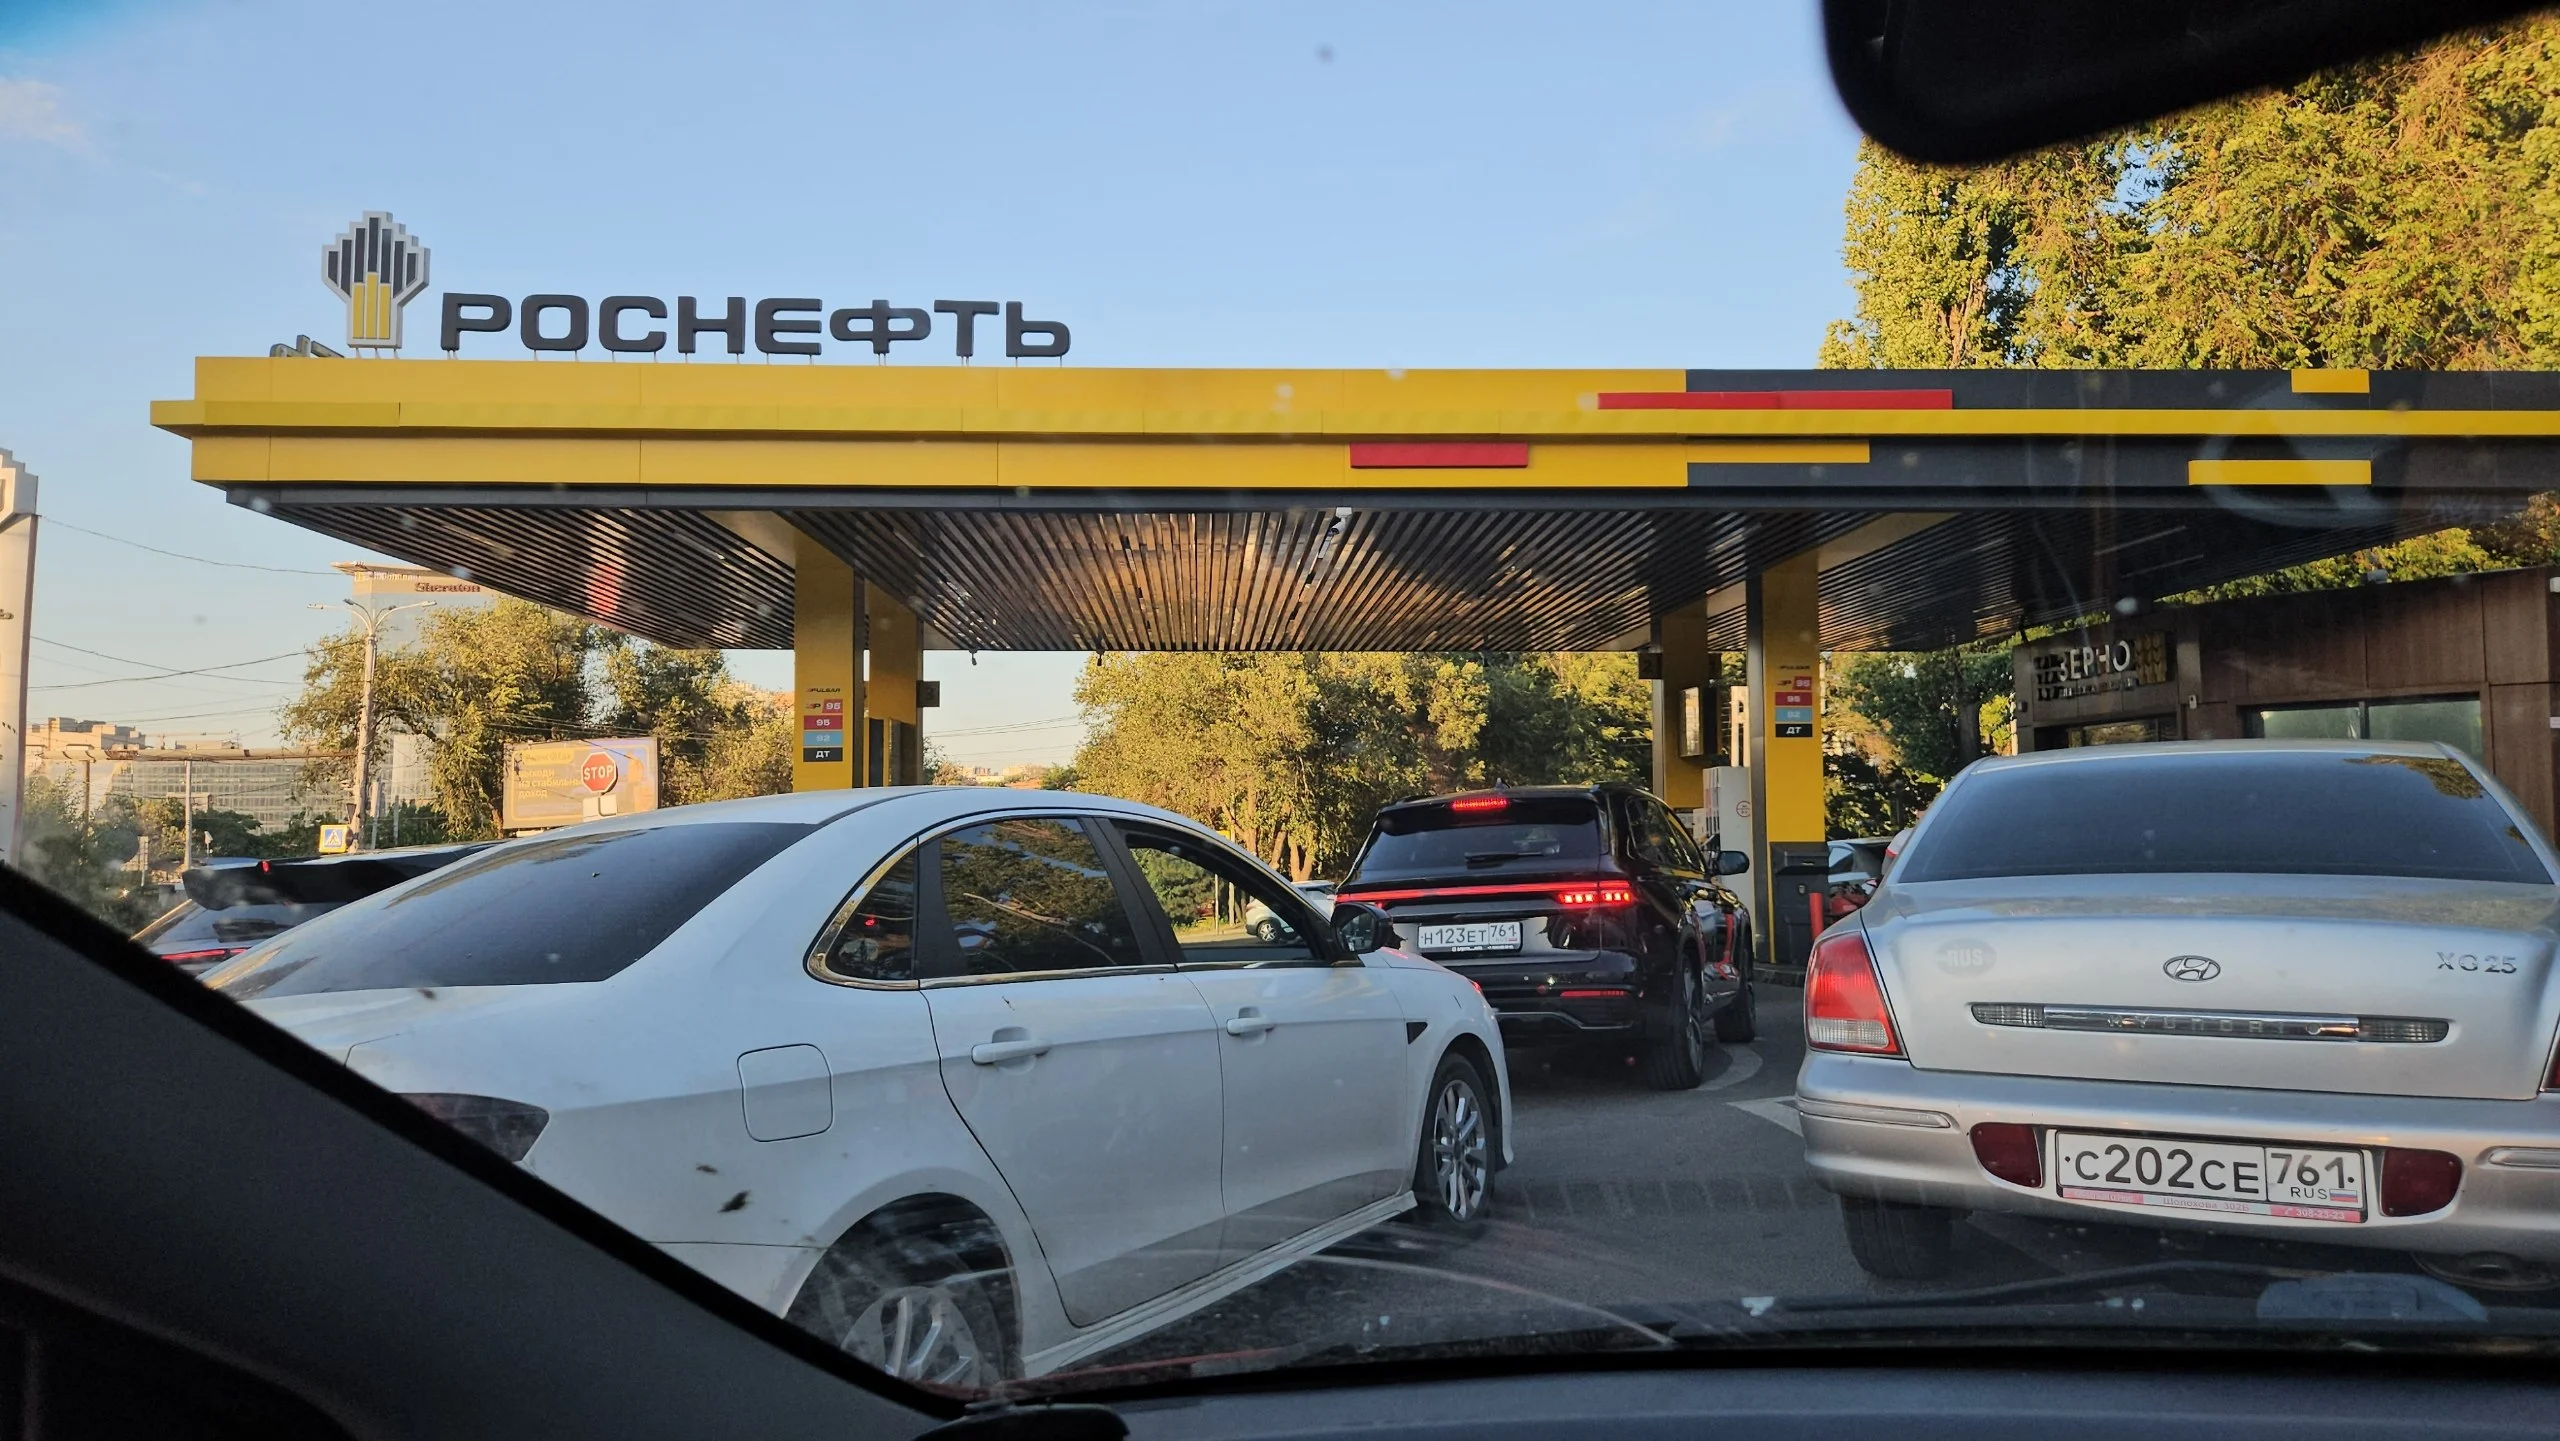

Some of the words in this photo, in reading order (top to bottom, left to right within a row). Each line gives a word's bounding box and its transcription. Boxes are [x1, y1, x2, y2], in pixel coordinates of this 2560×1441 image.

[440, 292, 1071, 358] РОСНЕФТЬ
[414, 581, 481, 593] Sheraton
[2059, 640, 2131, 682] ЗЕРНО
[825, 702, 841, 710] 95
[1786, 726, 1802, 735] ДТ
[815, 750, 830, 758] ДТ
[583, 765, 614, 780] STOP
[2271, 1152, 2345, 1189] 761
[2290, 1186, 2328, 1200] RUS
[2162, 1196, 2217, 1209] Шолохова
